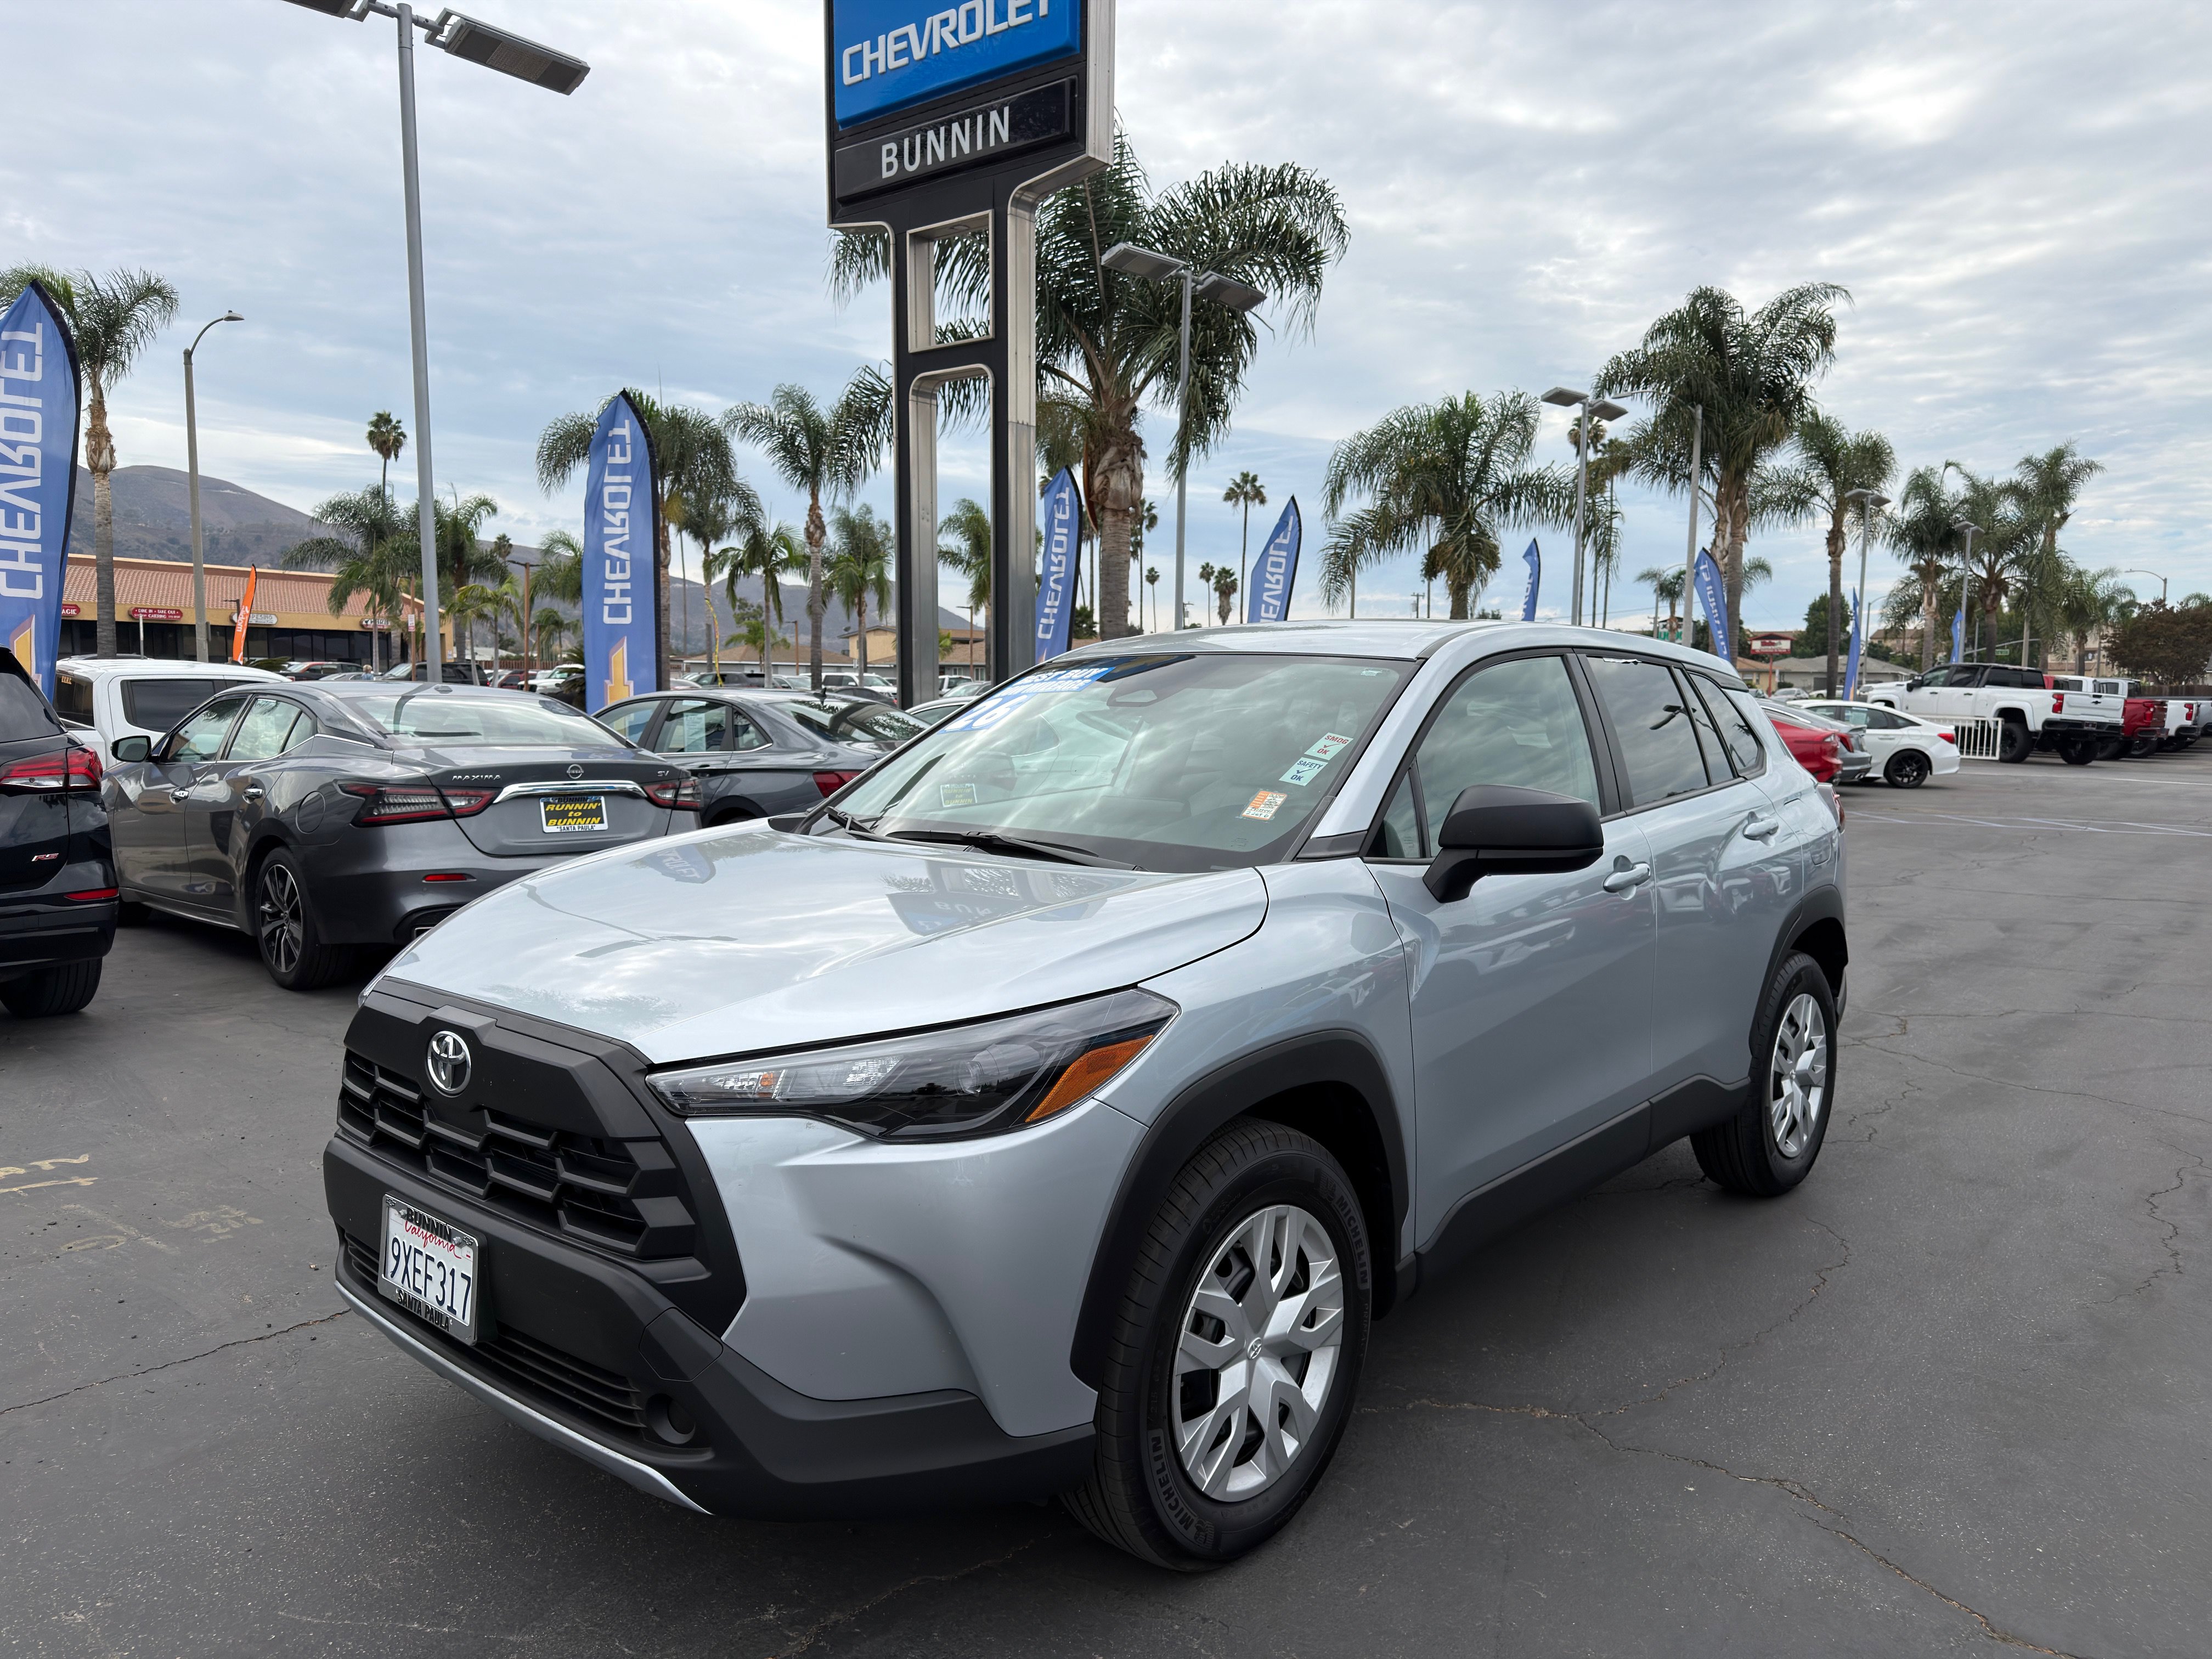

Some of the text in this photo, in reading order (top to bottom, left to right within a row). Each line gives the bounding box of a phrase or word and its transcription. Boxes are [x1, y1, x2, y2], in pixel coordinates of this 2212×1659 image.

[881, 106, 1010, 179] BUNNIN
[1063, 667, 1109, 680] BUY
[944, 695, 1028, 731] 26
[1324, 735, 1349, 744] SMOG
[1297, 760, 1323, 769] SAFETY
[545, 803, 601, 811] RUNNIN'
[548, 817, 601, 826] BUNNIN
[31, 853, 59, 861] RS
[407, 1206, 452, 1243] BUNNIN
[1335, 1195, 1368, 1285] MICHELIN
[391, 1237, 471, 1321] 9XEF317
[1152, 1435, 1194, 1531] MICHELIN
